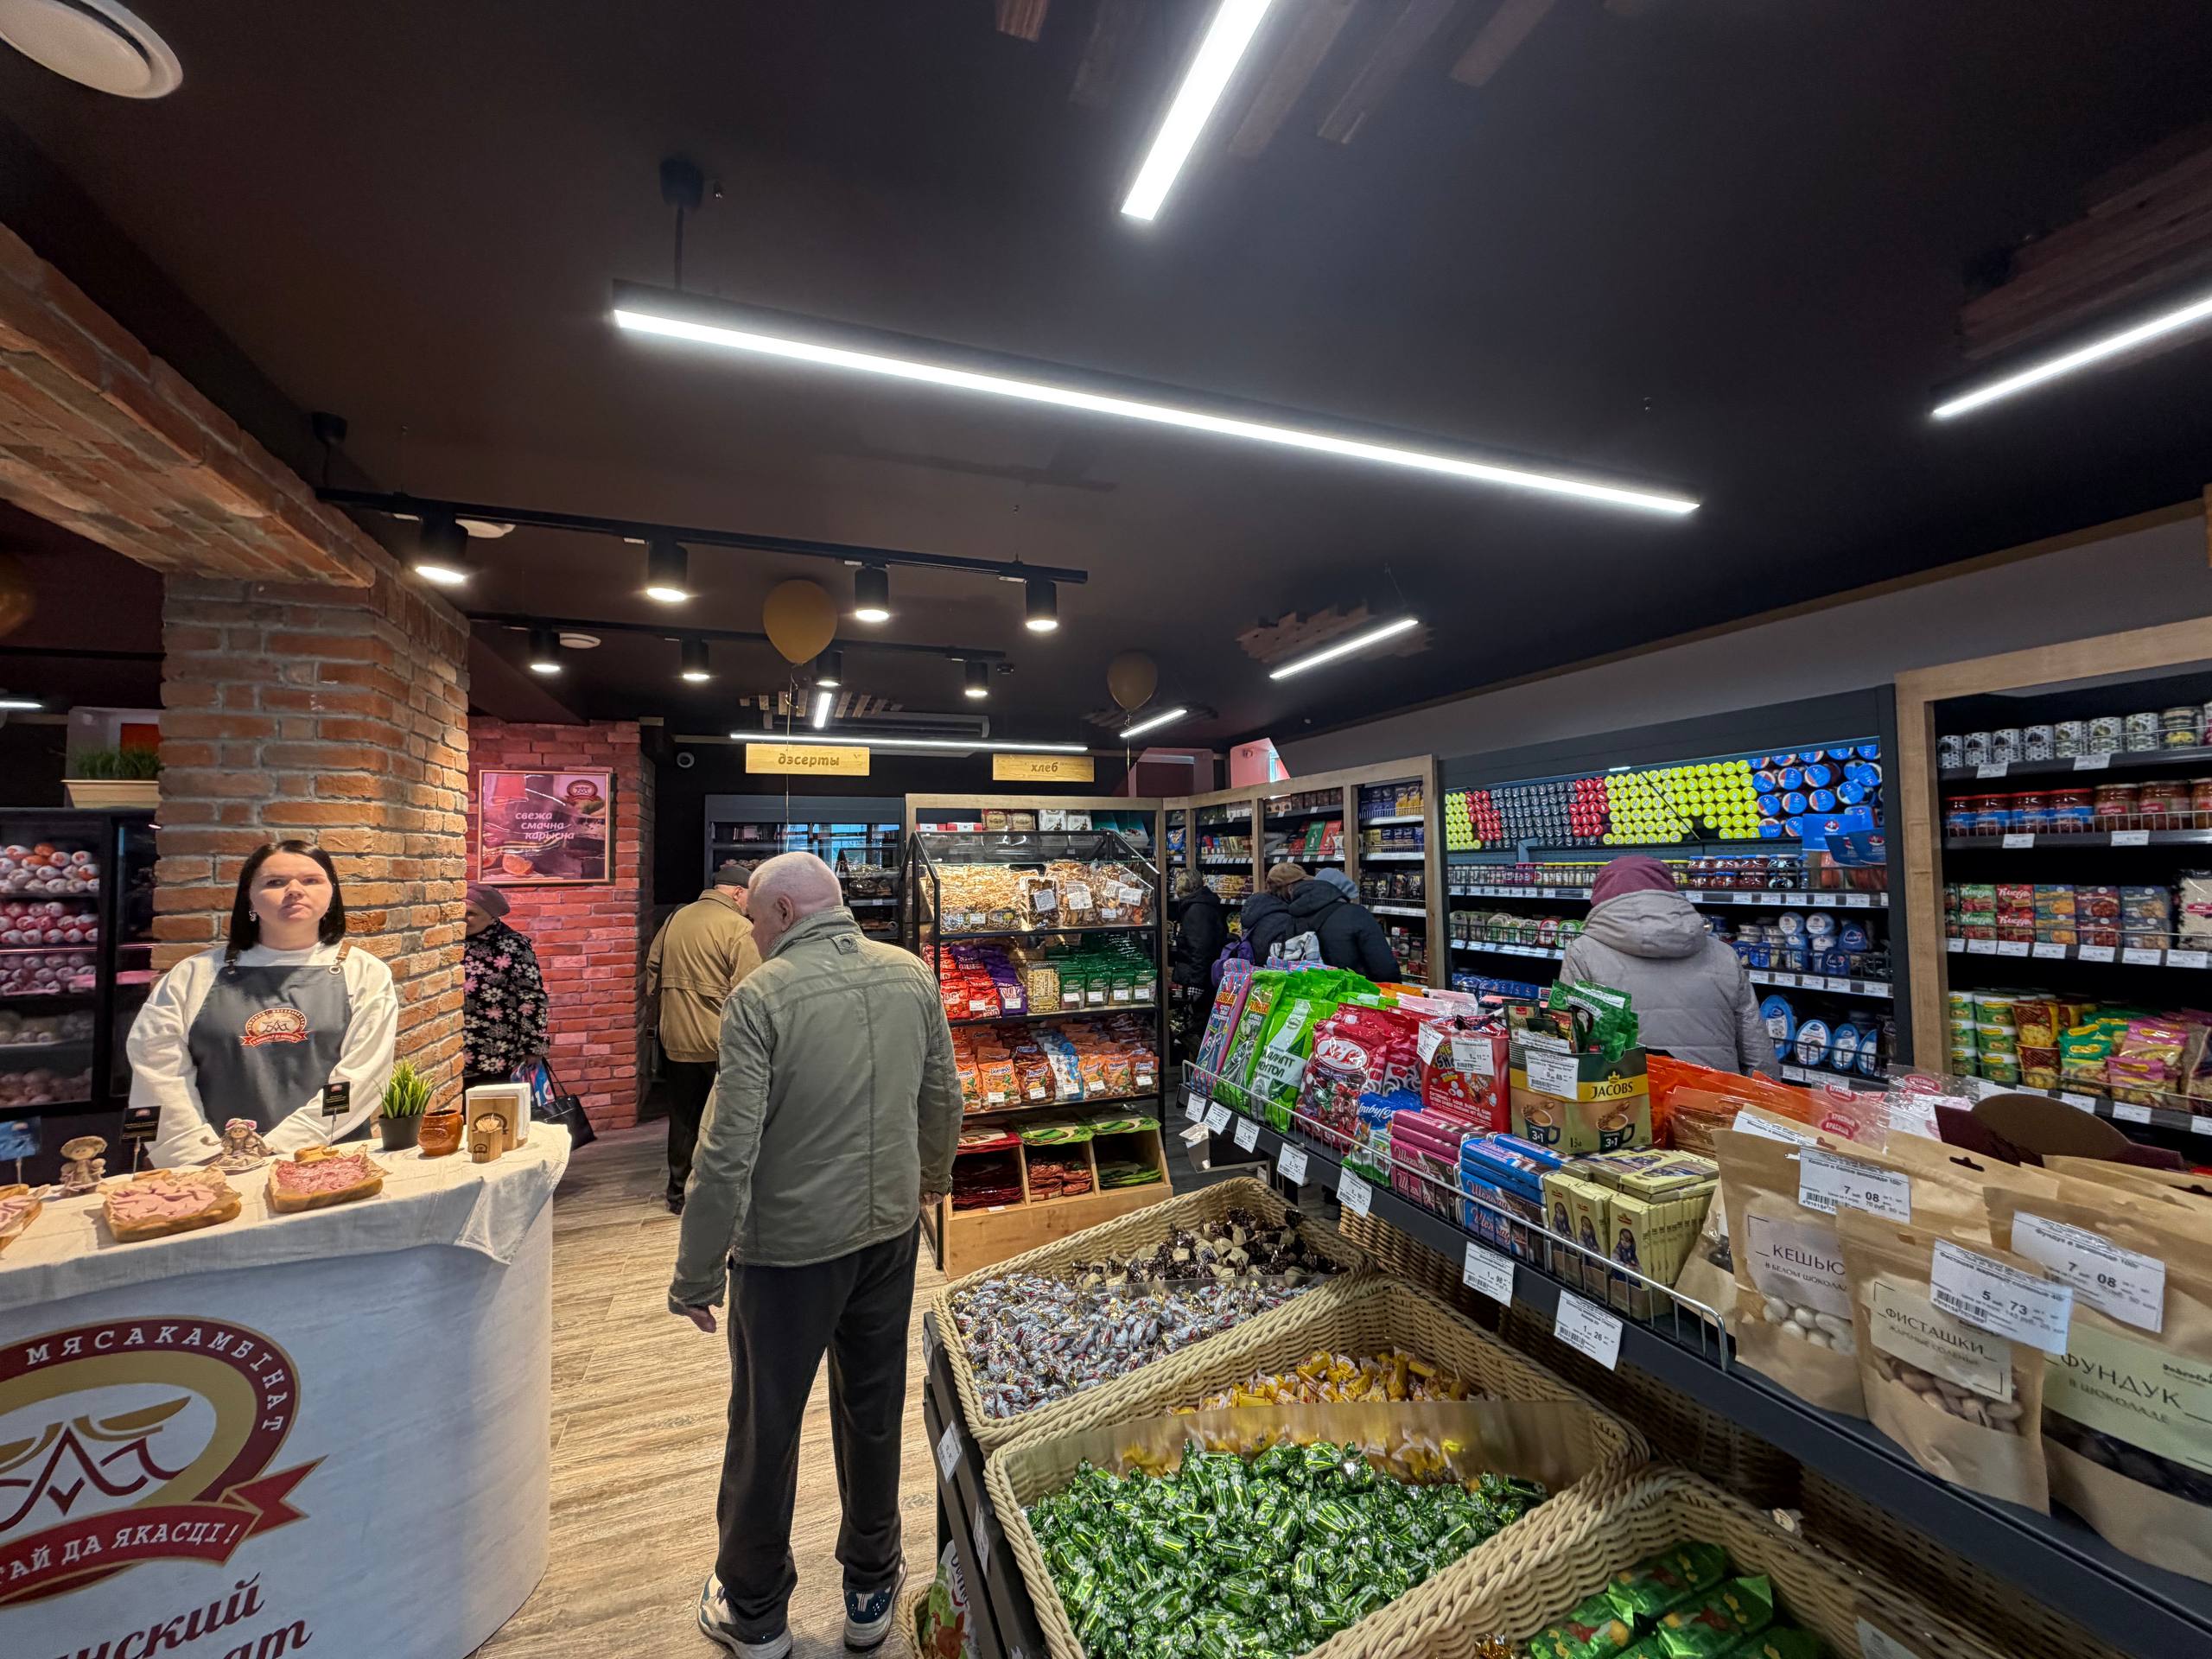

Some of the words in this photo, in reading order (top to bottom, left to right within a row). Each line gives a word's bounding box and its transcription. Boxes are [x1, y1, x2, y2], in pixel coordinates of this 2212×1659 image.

[778, 753, 840, 767] дэсерты
[1031, 762, 1058, 773] хлеб
[515, 811, 553, 820] свежа
[524, 831, 575, 842] карысна
[1591, 1082, 1633, 1099] JACOBS
[1358, 1103, 1393, 1122] babyfo
[1843, 1185, 1851, 1194] 7
[1866, 1192, 1879, 1203] 08
[1773, 1244, 1846, 1275] КЕШЬЮ
[1772, 1264, 1801, 1278] БЕЛОМ
[1802, 1273, 1848, 1292] ШОКОЛА
[2068, 1261, 2078, 1272] 7
[2097, 1273, 2116, 1288] 08
[1981, 1290, 1991, 1300] 5
[2010, 1300, 2028, 1315] 73
[1885, 1307, 1984, 1355] ФИСТАШКИ
[26, 1325, 286, 1433] МЯСАКАМБІНАТ
[2061, 1353, 2182, 1410] ФУНДУК
[60, 1535, 102, 1566] ДА
[111, 1523, 238, 1550] ЯКАСЦІ!
[57, 1572, 265, 1659] нский
